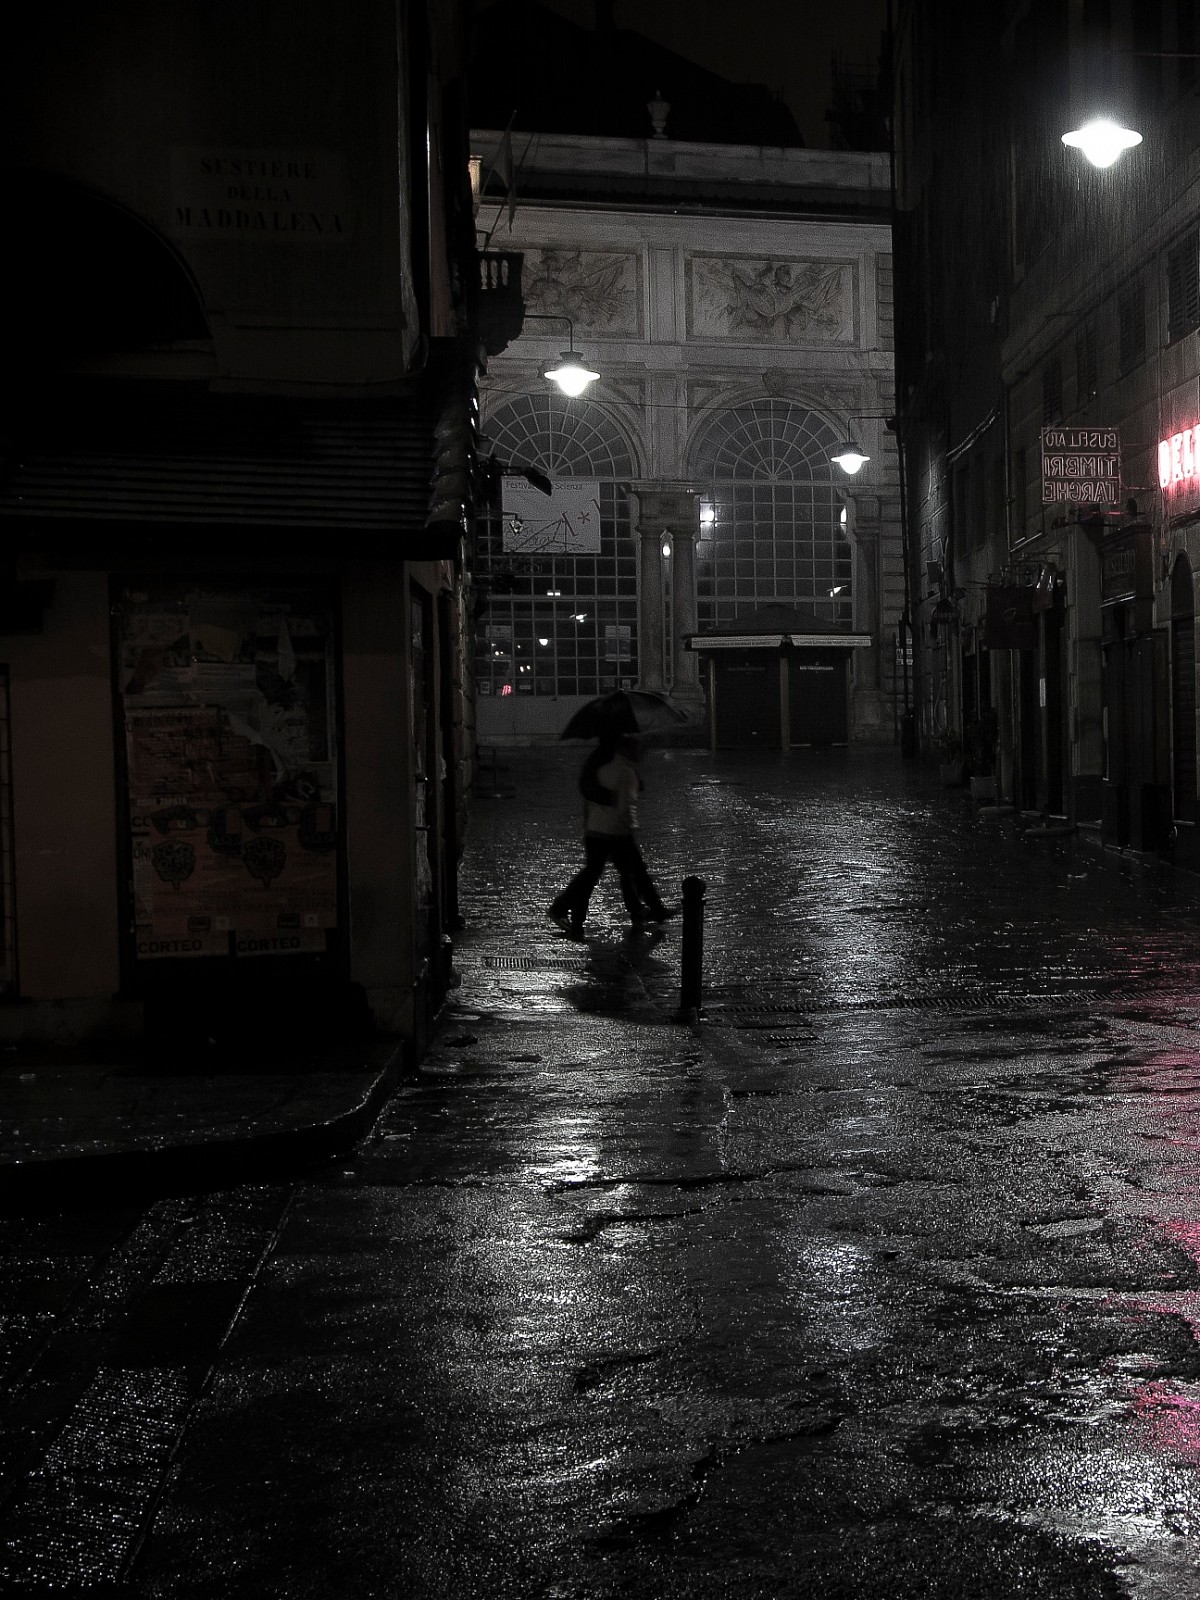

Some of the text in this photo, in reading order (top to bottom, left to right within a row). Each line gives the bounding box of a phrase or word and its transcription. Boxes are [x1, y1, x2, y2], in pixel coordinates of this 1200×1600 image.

[199, 157, 317, 179] SESTIERE
[227, 186, 292, 202] DELLA
[175, 207, 344, 233] MADDALENA
[505, 480, 533, 491] Festiva
[137, 936, 301, 954] CORTEO CORTEO
